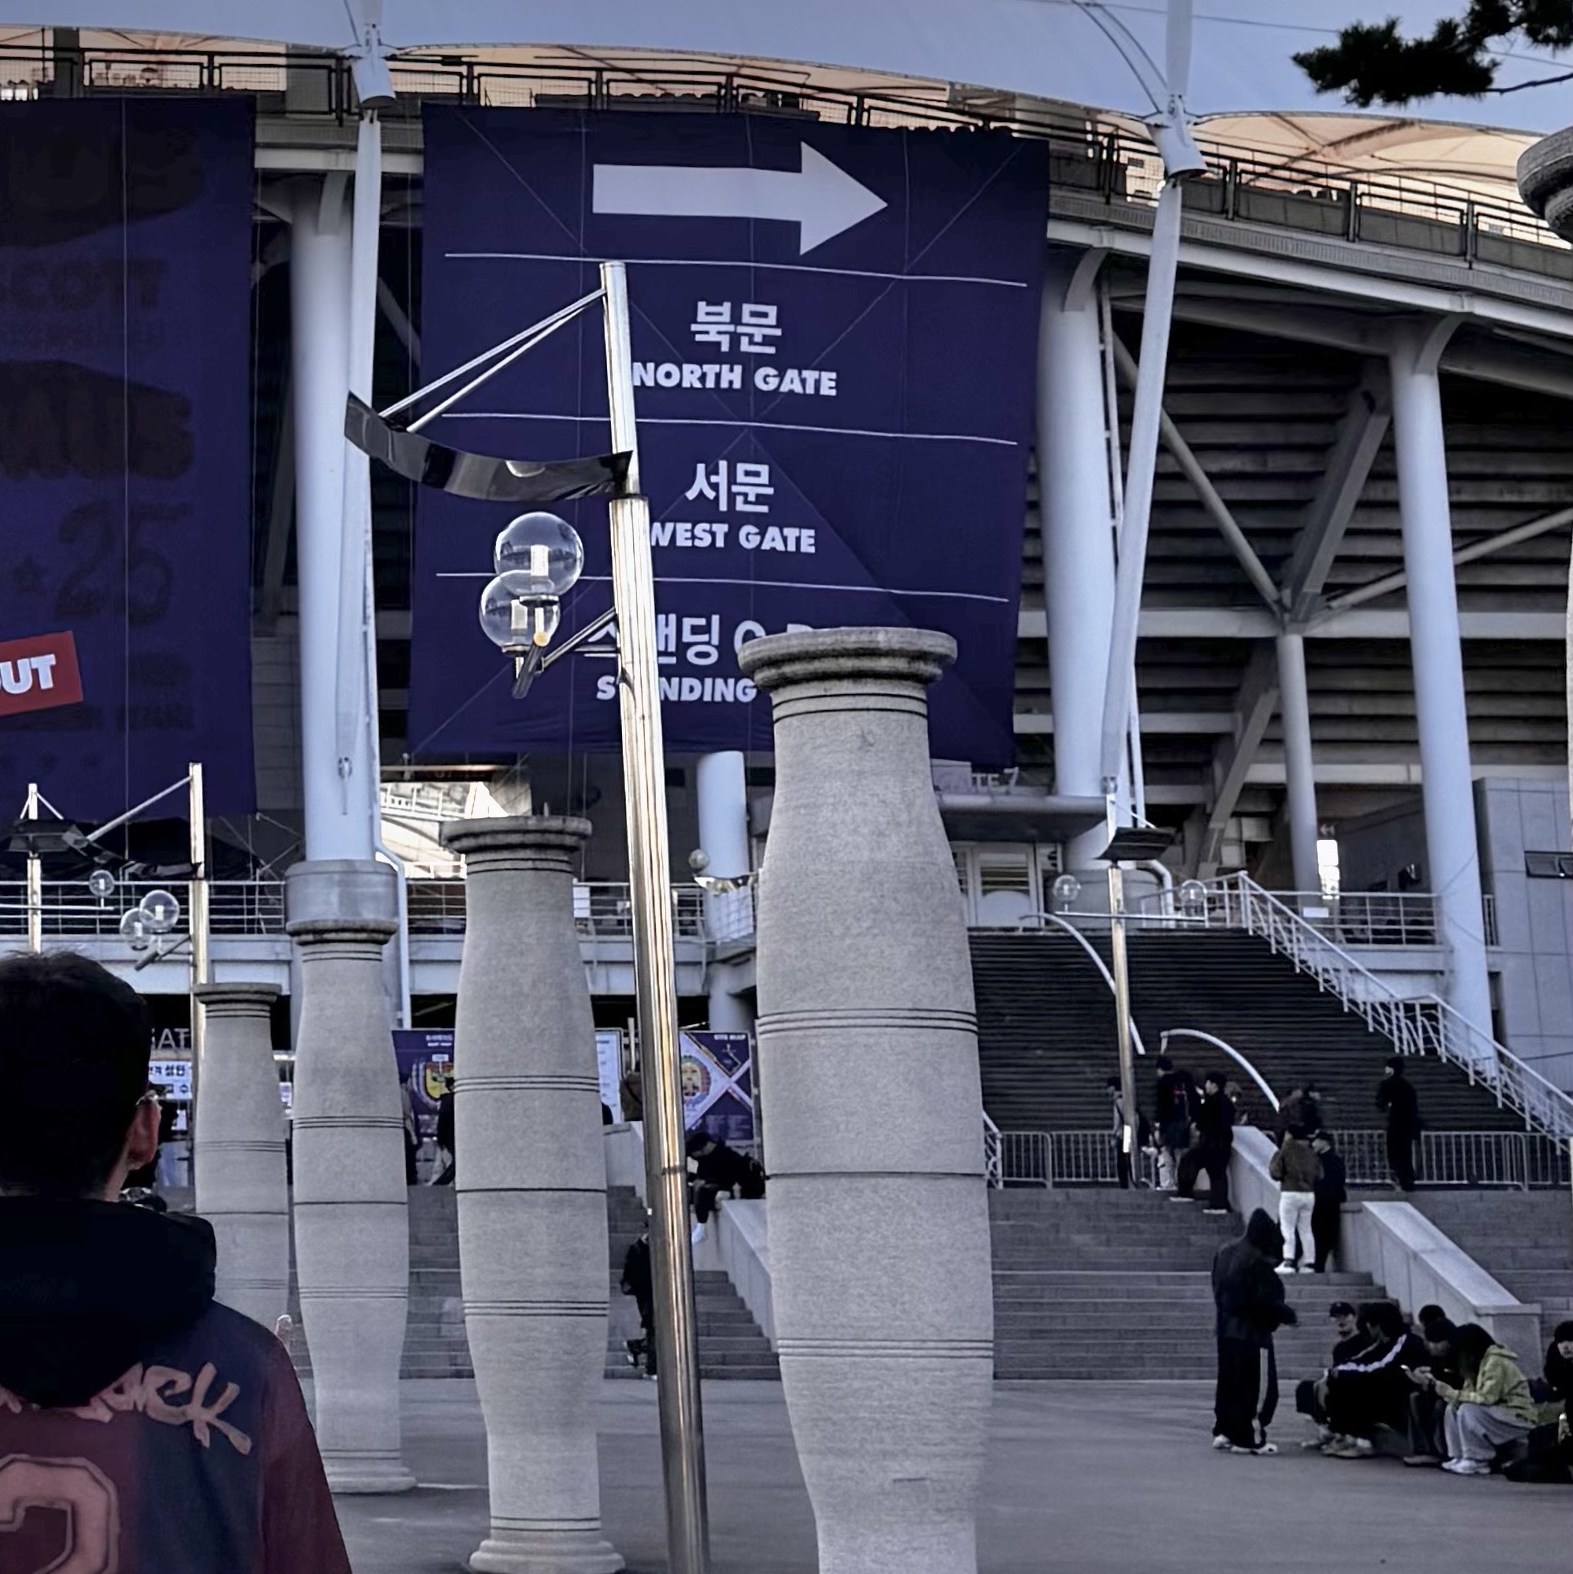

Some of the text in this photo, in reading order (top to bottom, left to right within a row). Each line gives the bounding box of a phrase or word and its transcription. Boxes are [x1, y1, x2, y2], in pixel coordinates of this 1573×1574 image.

[690, 301, 782, 354] 북문
[632, 362, 837, 396] NORTH GATE
[685, 460, 774, 513] 서문
[649, 522, 816, 554] WEST GATE
[596, 675, 757, 703] SNDING
